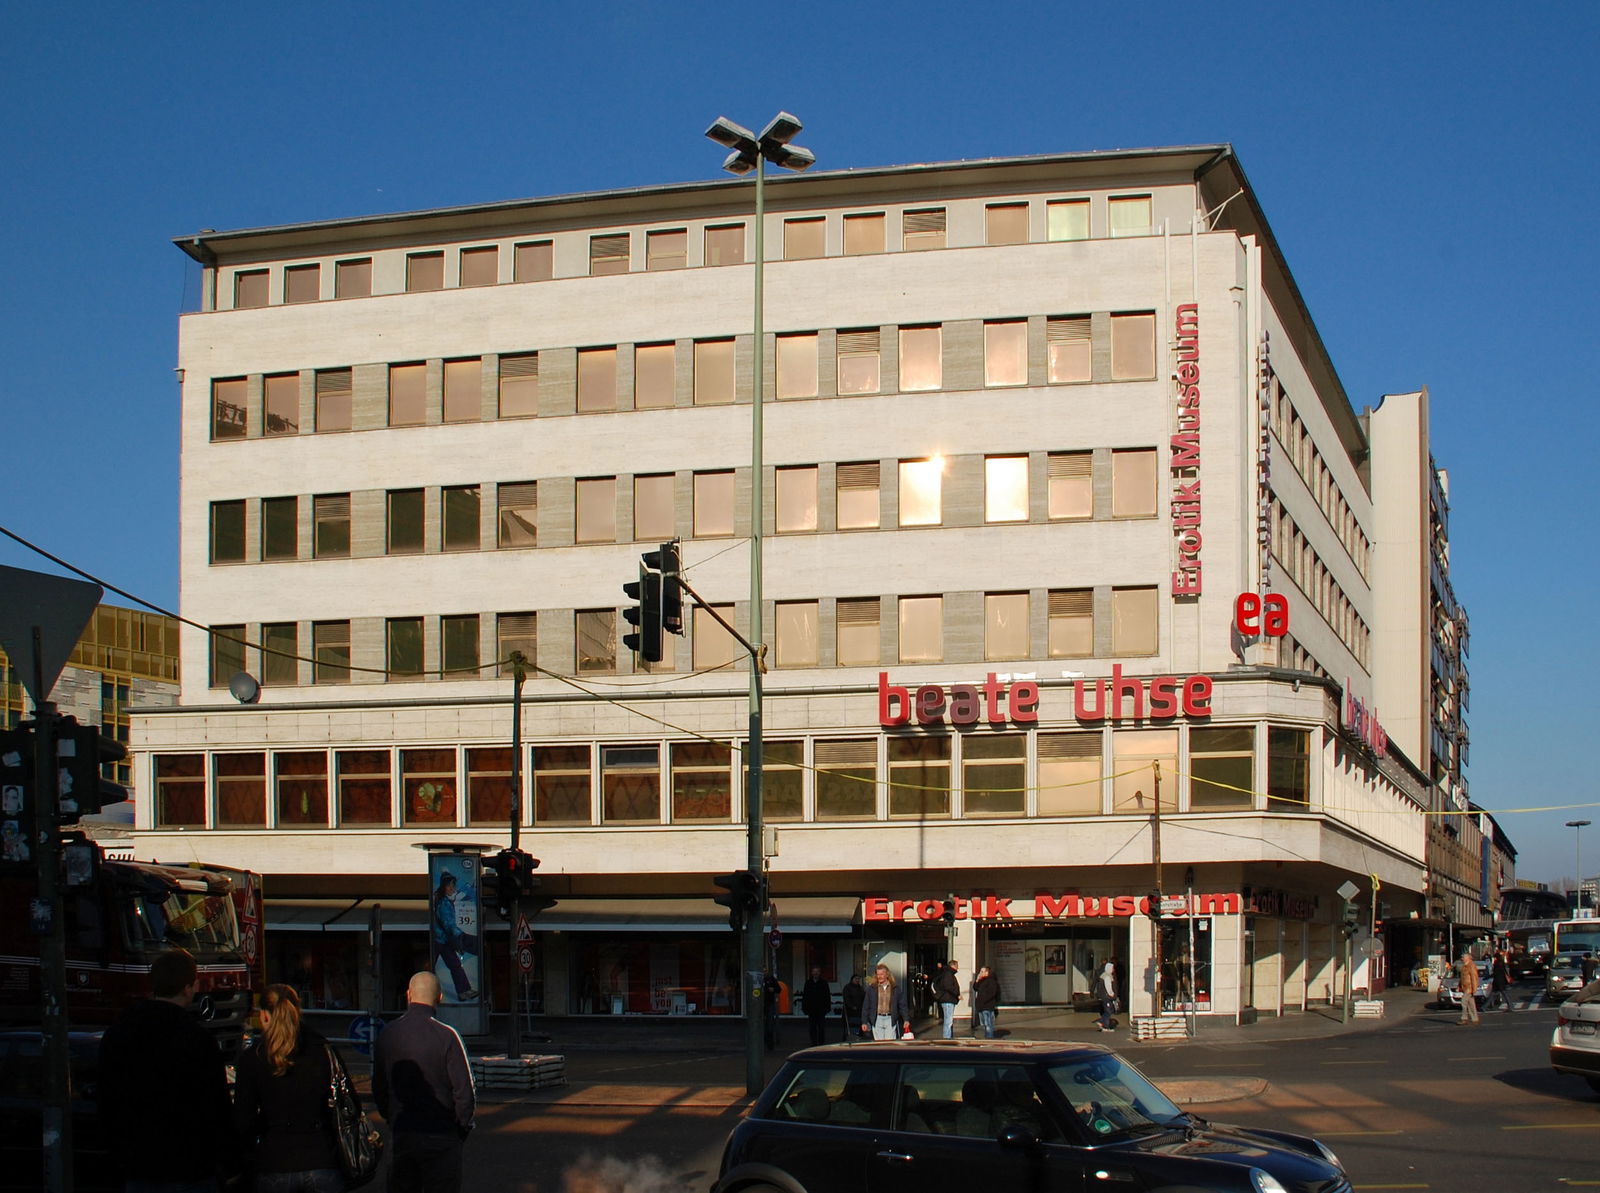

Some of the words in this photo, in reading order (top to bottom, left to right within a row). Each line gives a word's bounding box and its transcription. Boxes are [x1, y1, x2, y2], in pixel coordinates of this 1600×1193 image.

[1170, 303, 1201, 468] Museum
[1172, 480, 1202, 596] Erotik
[878, 671, 1039, 727] beate
[1074, 663, 1213, 720] uhse
[865, 896, 1012, 920] Erotik
[521, 951, 530, 964] 30
